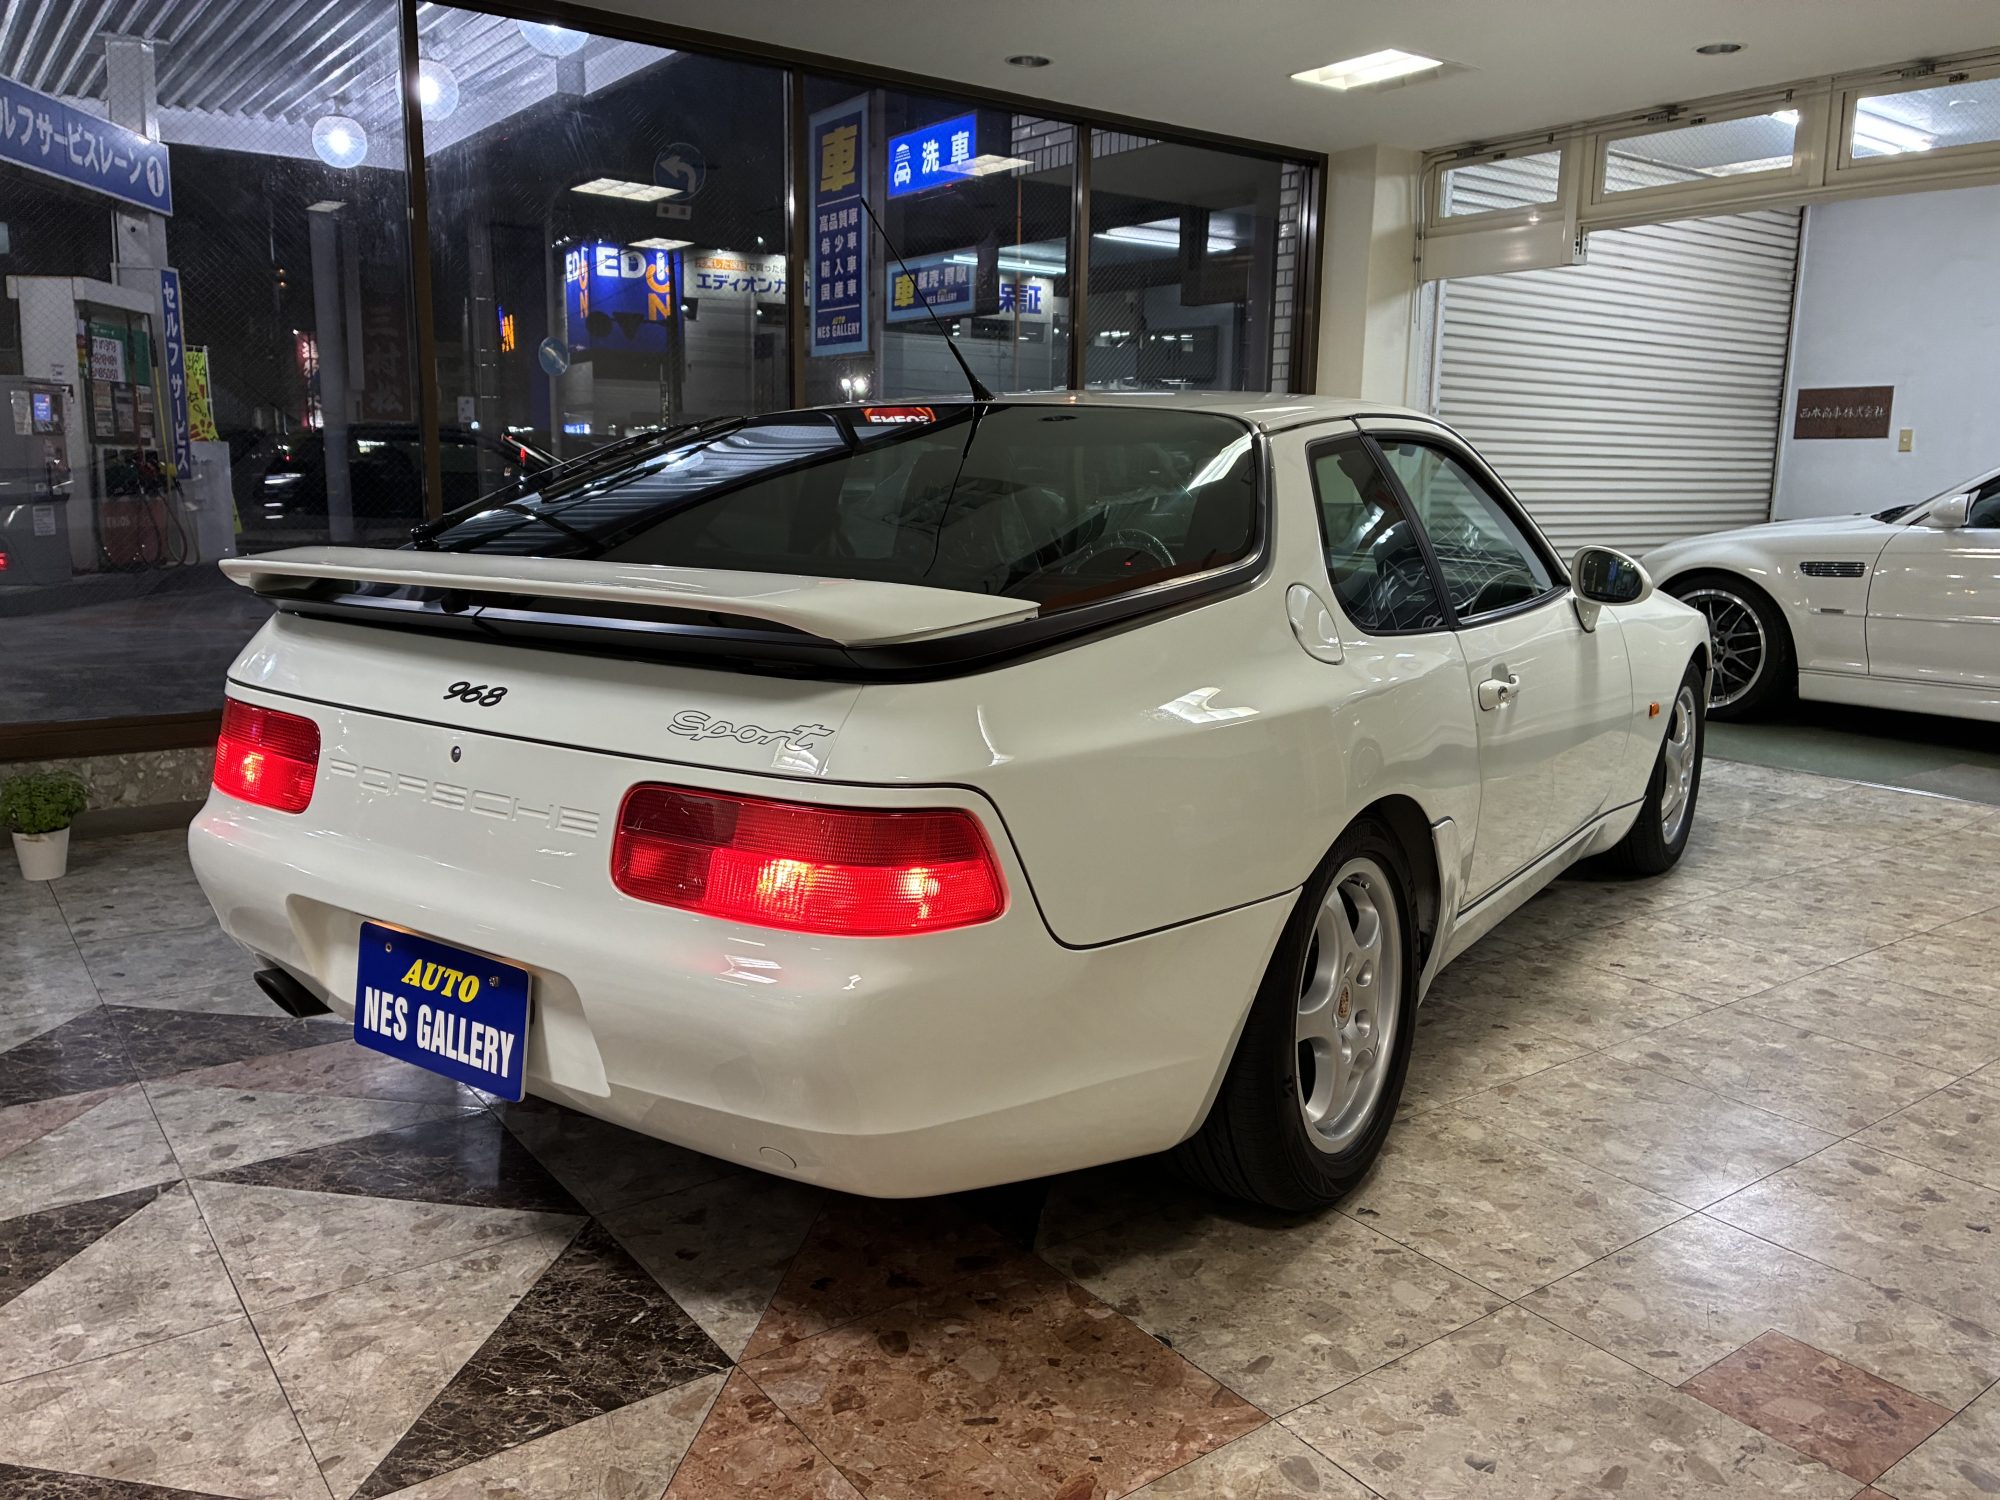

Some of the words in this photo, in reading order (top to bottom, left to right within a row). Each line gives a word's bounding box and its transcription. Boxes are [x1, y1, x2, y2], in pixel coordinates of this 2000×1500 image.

[821, 124, 857, 192] 車
[922, 131, 970, 174] 洗車
[820, 208, 858, 233] 高品質車
[821, 232, 857, 255] 希少車
[821, 279, 857, 301] 国産車
[895, 273, 915, 307] 車
[817, 326, 830, 339] NES
[832, 322, 860, 337] GALLERY
[163, 281, 188, 471] セルフサービス
[443, 681, 508, 707] 968
[667, 710, 835, 751] Sport
[325, 757, 600, 838] PORSCHE
[401, 959, 480, 1003] AUTO
[363, 986, 408, 1041] NES
[416, 1004, 515, 1078] GALLERY
